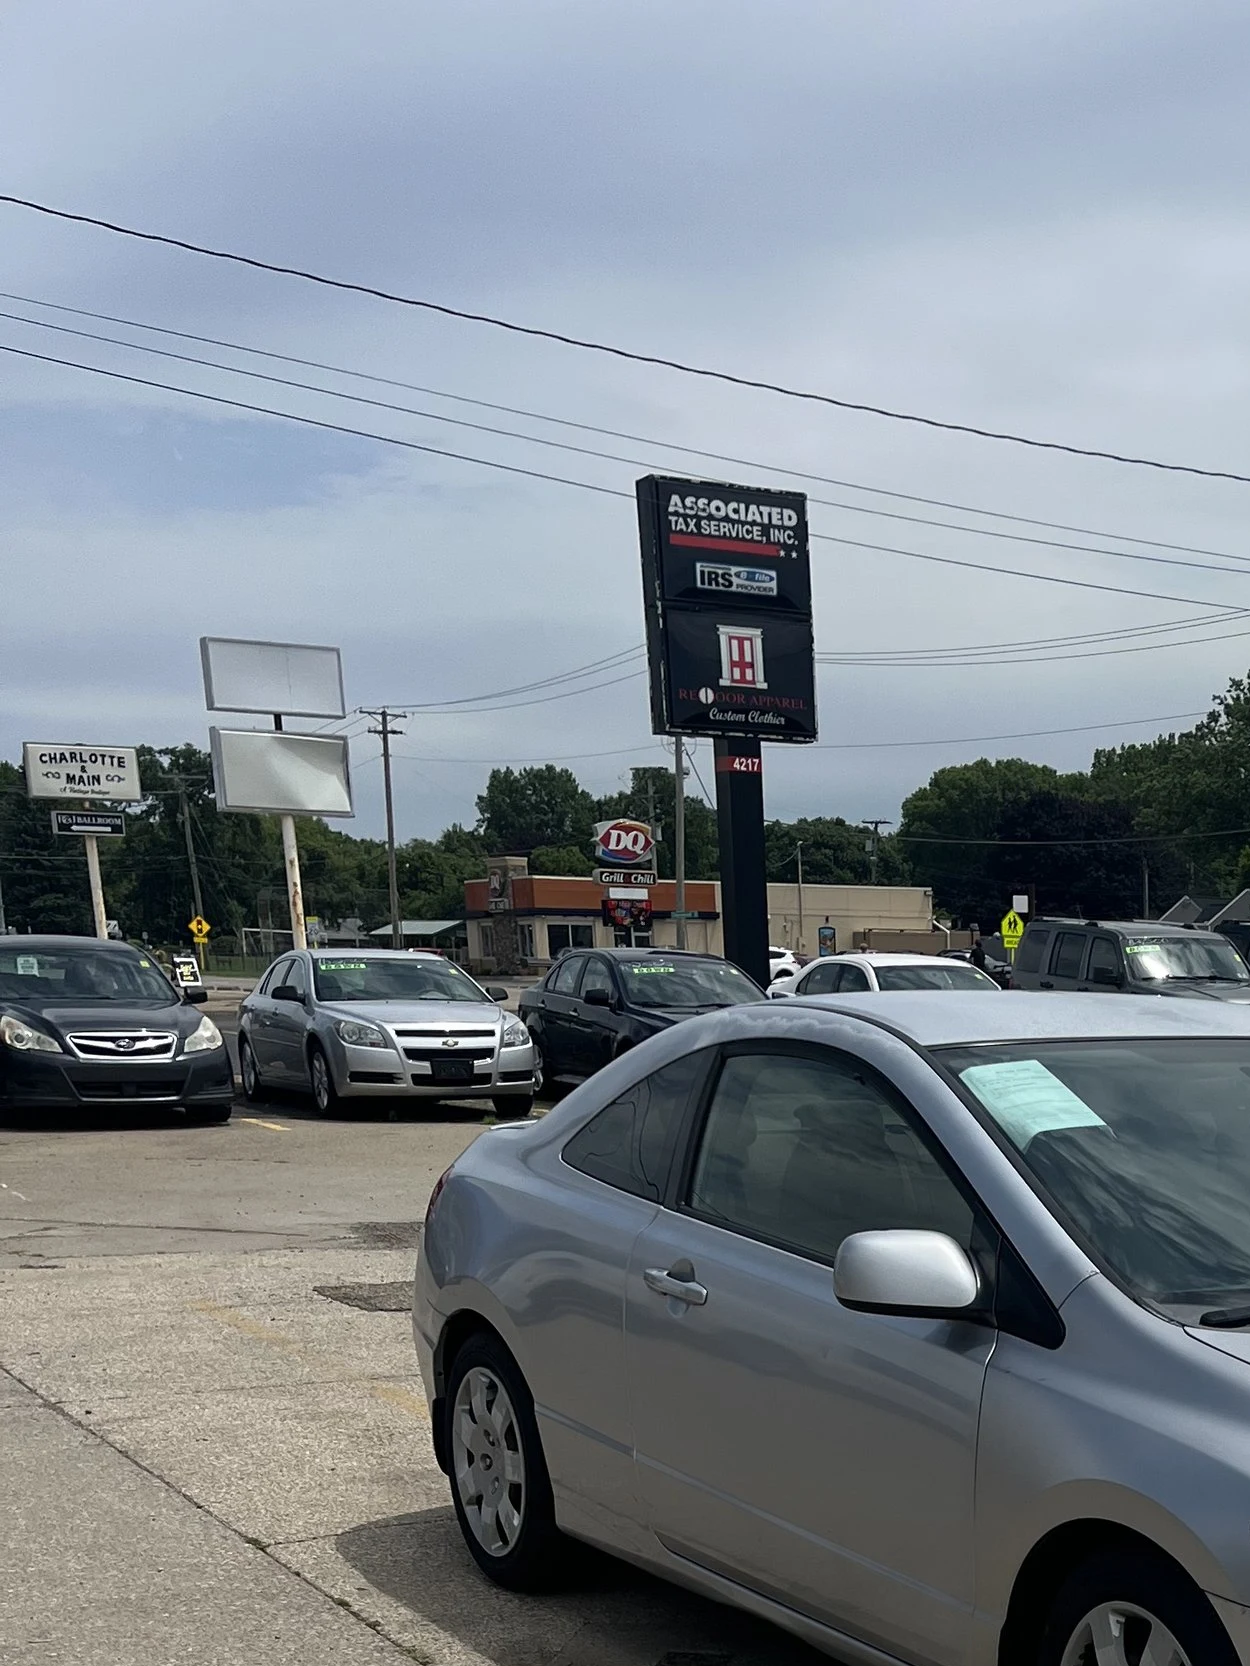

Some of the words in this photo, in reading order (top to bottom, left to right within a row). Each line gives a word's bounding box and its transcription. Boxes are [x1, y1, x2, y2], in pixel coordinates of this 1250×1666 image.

[668, 494, 798, 527] ASSOCIATED
[668, 515, 698, 534] TAX
[701, 519, 766, 544] SERVICE,
[770, 527, 798, 545] INC.
[700, 569, 733, 589] IRS
[735, 583, 775, 594] PROVIDER
[748, 695, 808, 710] APPAREL
[709, 707, 746, 722] Custom
[748, 710, 785, 725] Clothier
[39, 751, 126, 768] CHARLOTTE
[733, 757, 760, 772] 4217
[80, 765, 88, 773] &
[65, 773, 101, 787] MAIN
[77, 816, 122, 825] BALLROOM
[608, 829, 646, 854] DQ
[602, 872, 624, 883] Grill
[631, 873, 654, 885] Chill
